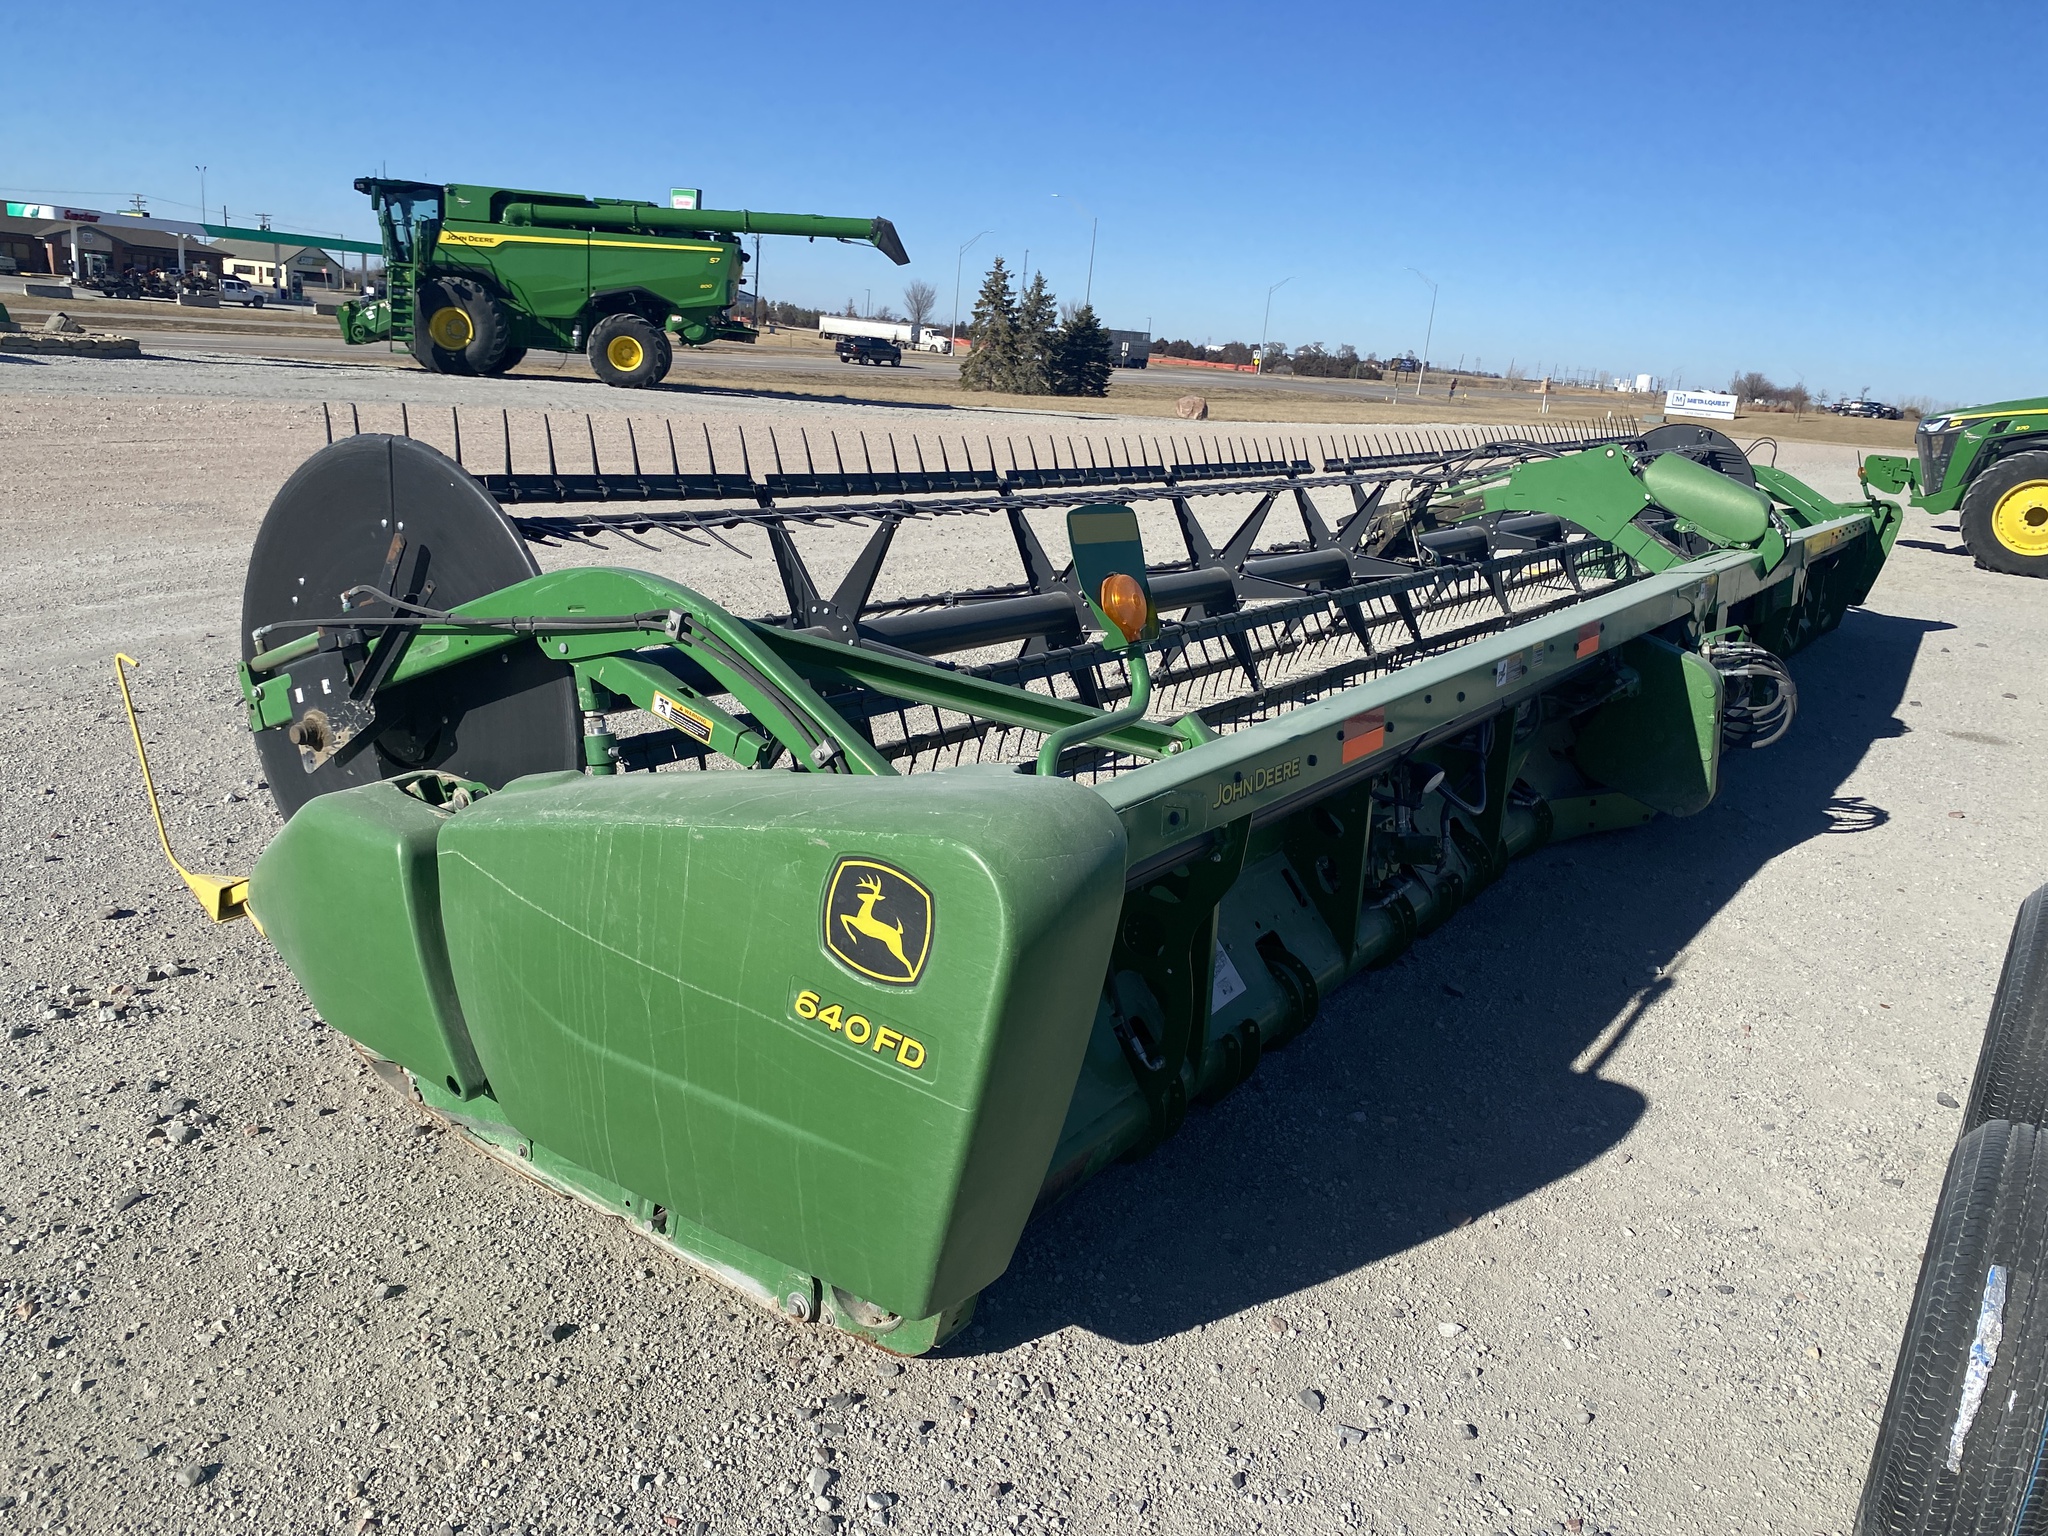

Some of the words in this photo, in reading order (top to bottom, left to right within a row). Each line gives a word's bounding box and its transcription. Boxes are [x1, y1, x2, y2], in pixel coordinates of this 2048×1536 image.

[468, 235, 495, 243] DEERE
[684, 708, 707, 725] WARNING
[1212, 774, 1254, 810] JOHN
[1254, 756, 1301, 793] DEERE
[794, 989, 928, 1070] 640FD
